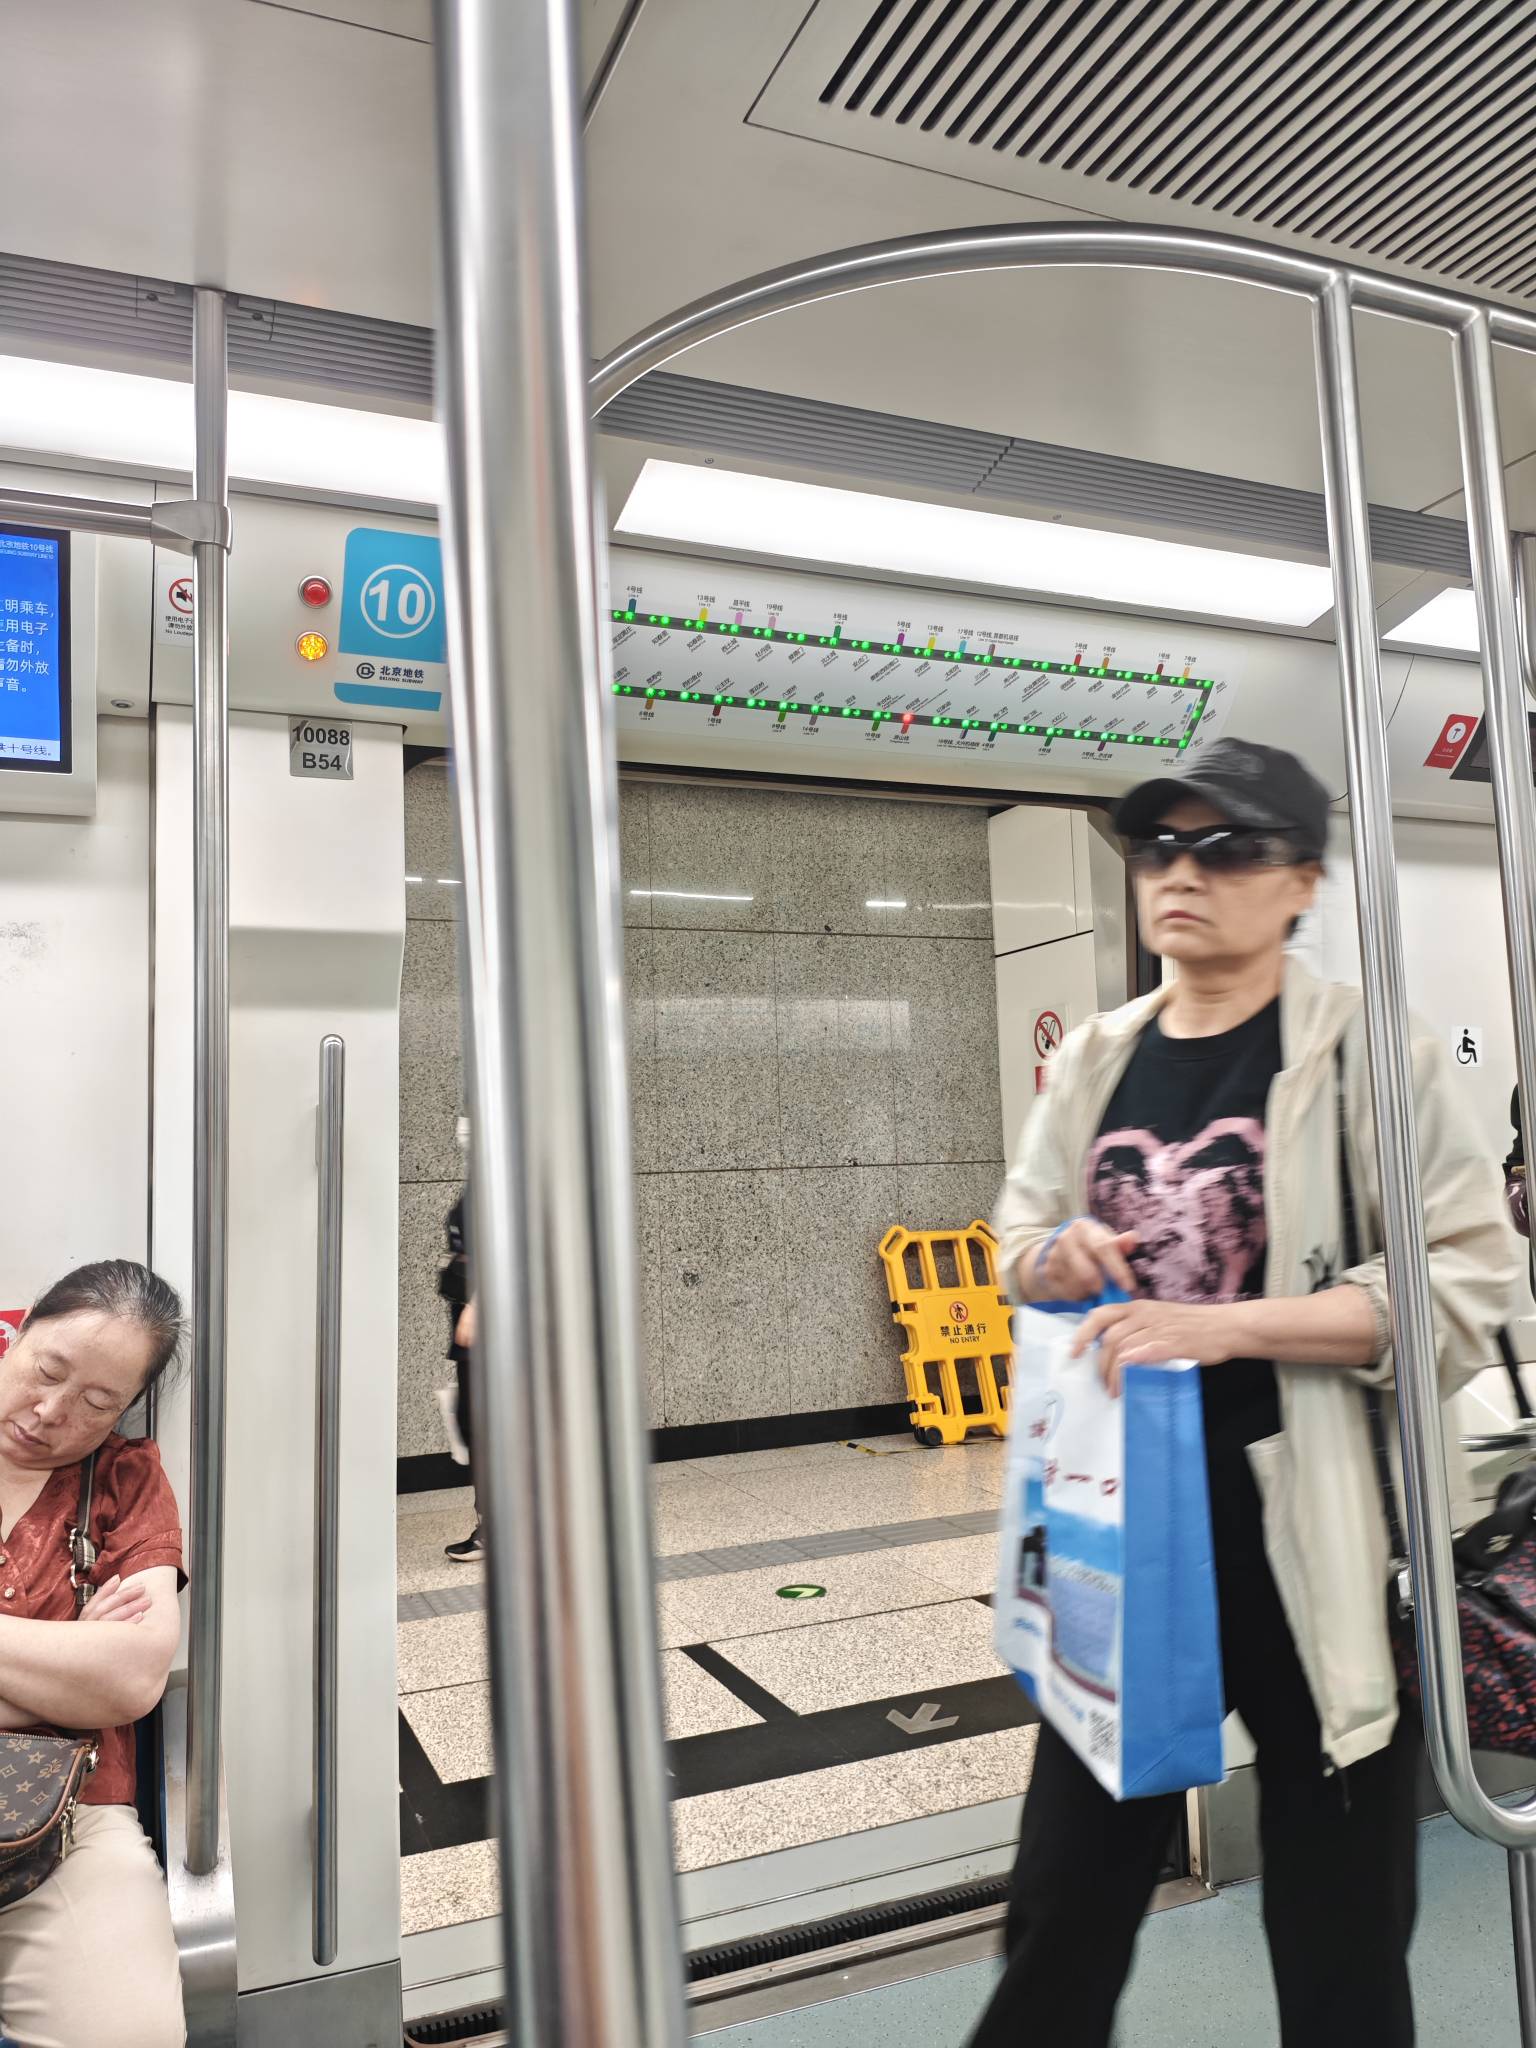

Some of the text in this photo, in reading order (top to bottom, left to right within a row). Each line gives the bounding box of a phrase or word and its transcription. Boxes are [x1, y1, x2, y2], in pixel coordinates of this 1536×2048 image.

[0, 599, 54, 618] 明乘车，
[368, 579, 426, 626] 10
[165, 615, 193, 624] 使用电子
[0, 639, 40, 656] 备时，
[380, 665, 424, 679] 北京地铁
[292, 726, 350, 746] 10088
[302, 752, 342, 771] B54
[940, 1322, 988, 1337] 禁止通行
[961, 1335, 980, 1344] ENTRY
